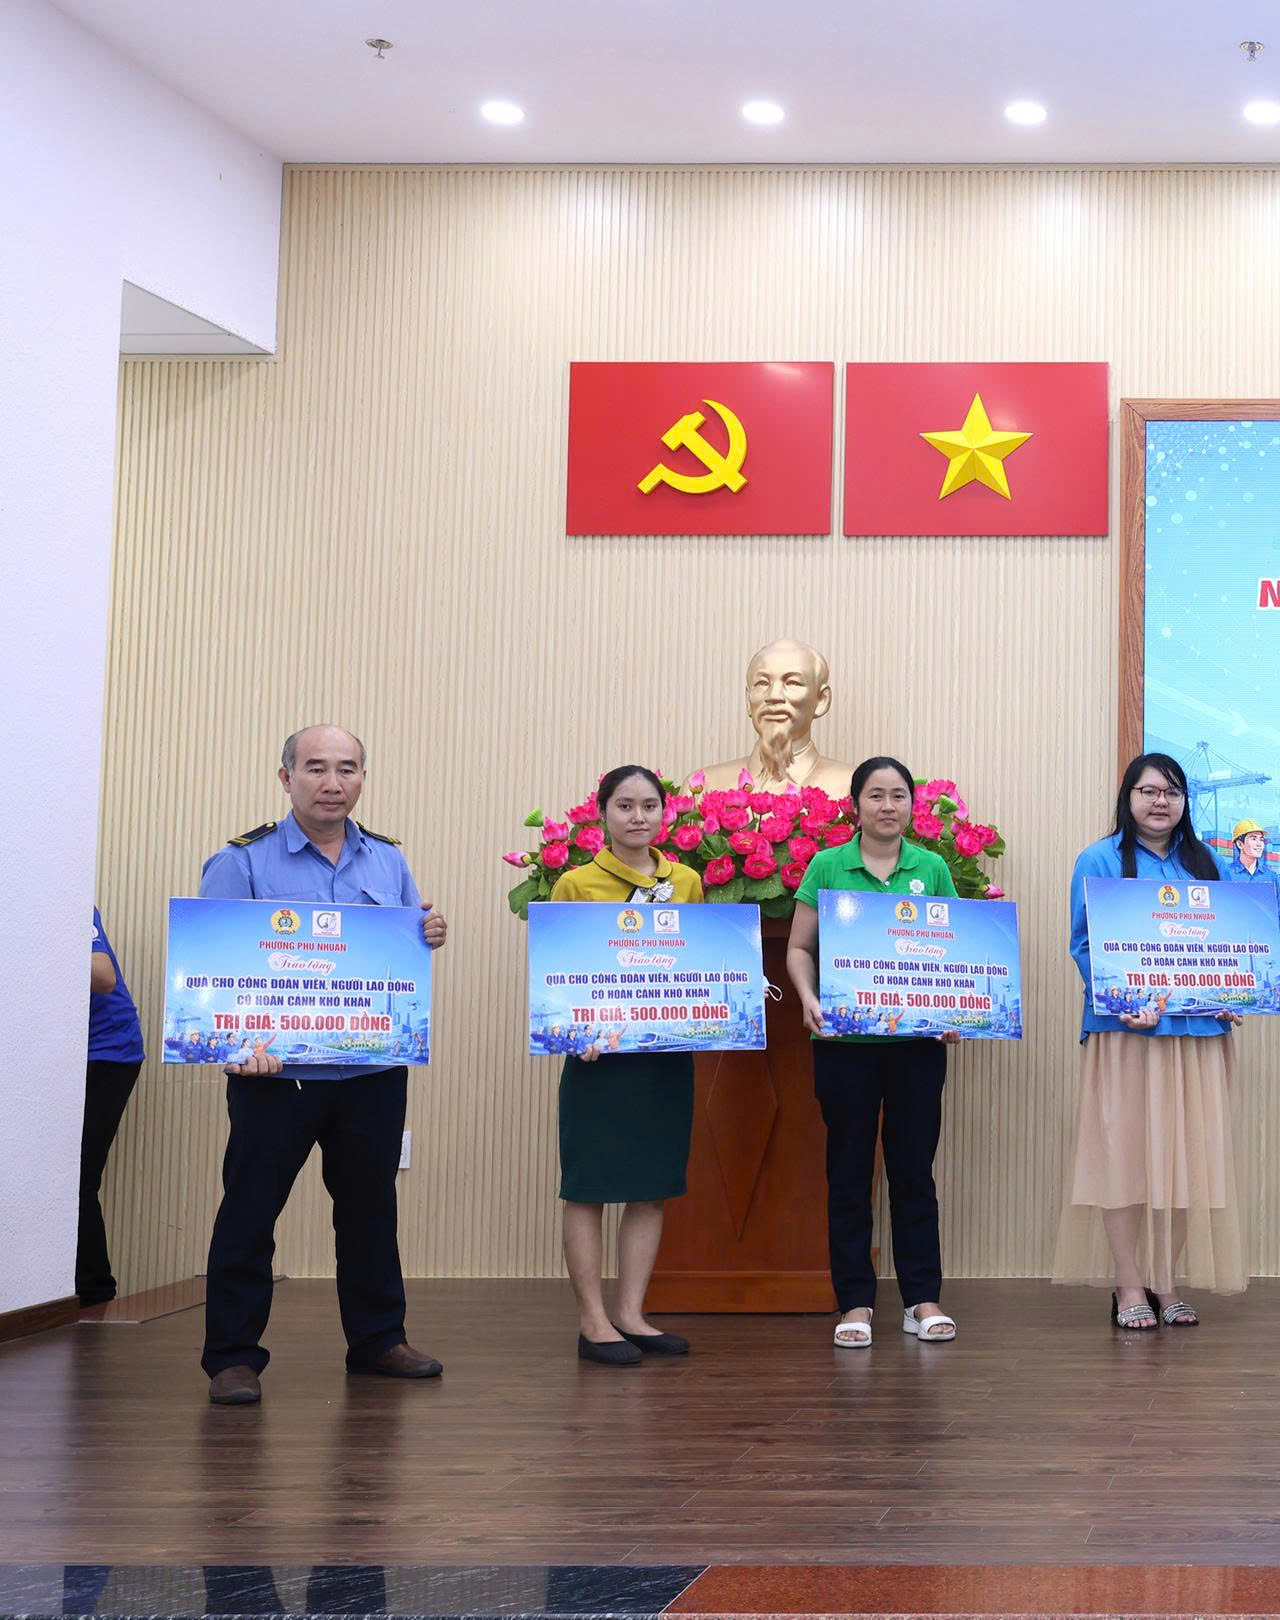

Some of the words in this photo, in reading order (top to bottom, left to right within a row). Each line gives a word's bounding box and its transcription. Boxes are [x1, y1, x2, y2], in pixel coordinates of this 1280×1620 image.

[1122, 943, 1138, 952] CHO
[1233, 945, 1247, 953] LAO
[854, 960, 869, 969] CHO
[970, 966, 985, 974] LAO
[212, 978, 234, 989] CHO
[367, 981, 384, 991] LAO
[569, 975, 588, 984] CHO
[704, 973, 720, 982] LAO
[1174, 974, 1221, 987] 500.000
[907, 995, 956, 1008] 500.000
[631, 1007, 687, 1021] 500.000
[281, 1015, 345, 1030] 500.000
